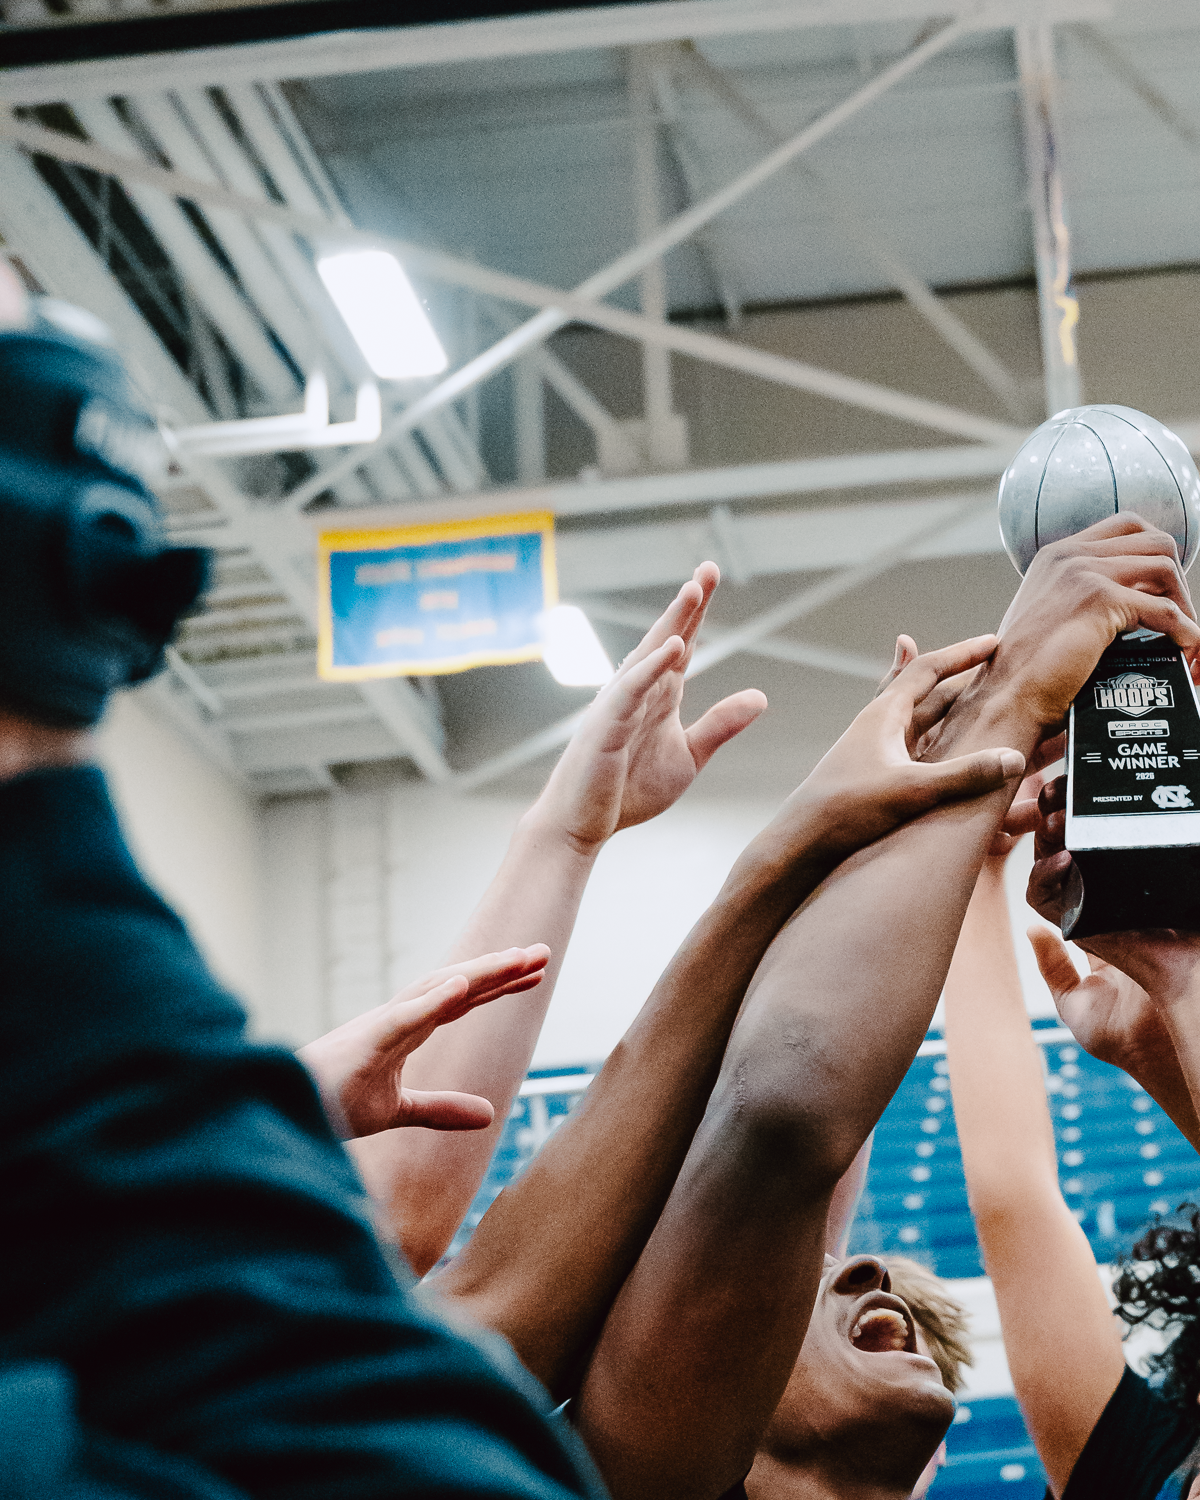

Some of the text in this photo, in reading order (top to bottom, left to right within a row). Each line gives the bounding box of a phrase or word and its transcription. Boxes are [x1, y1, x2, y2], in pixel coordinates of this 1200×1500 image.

[1100, 688, 1169, 707] HOOPS
[1117, 742, 1168, 756] GAME
[1107, 755, 1181, 770] WINNER
[1092, 795, 1133, 803] PRESENTED
